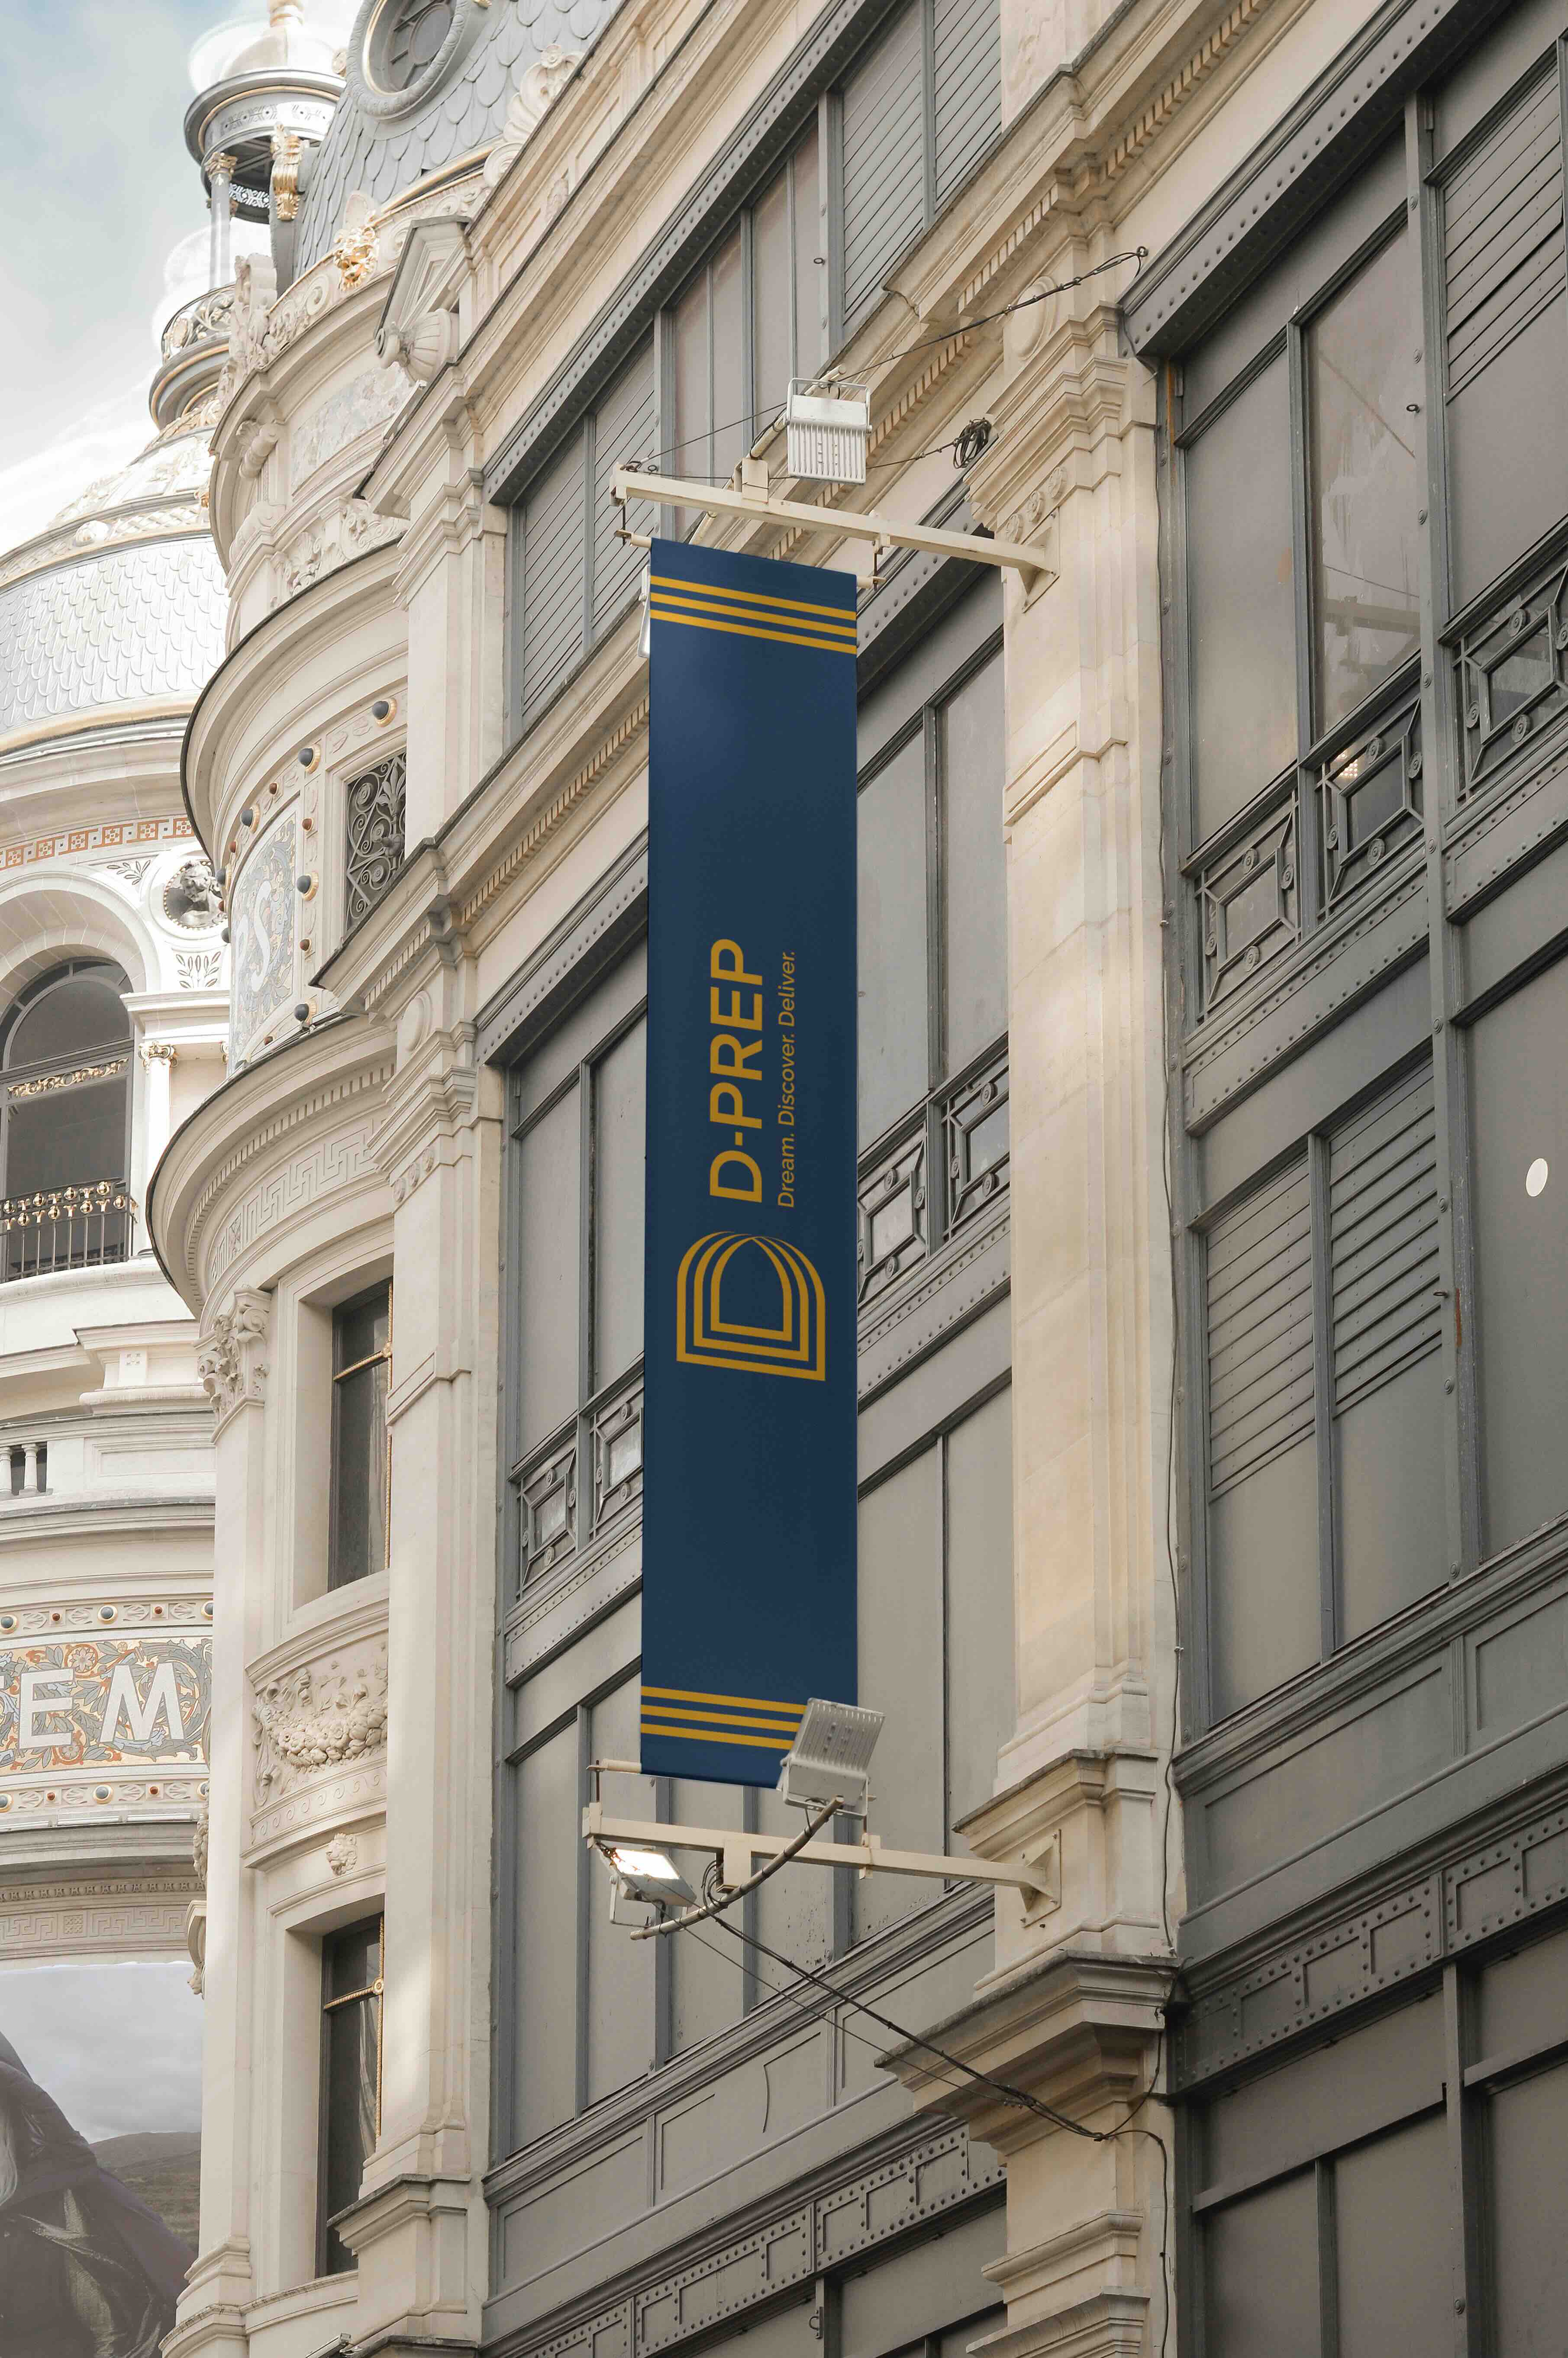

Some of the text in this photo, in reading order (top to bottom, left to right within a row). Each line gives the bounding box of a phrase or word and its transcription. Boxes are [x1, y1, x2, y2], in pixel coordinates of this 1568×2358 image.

[709, 939, 762, 1203] D-PREP
[778, 952, 796, 1208] Dream. Discover. Deliver.
[0, 1661, 185, 1749] EM
